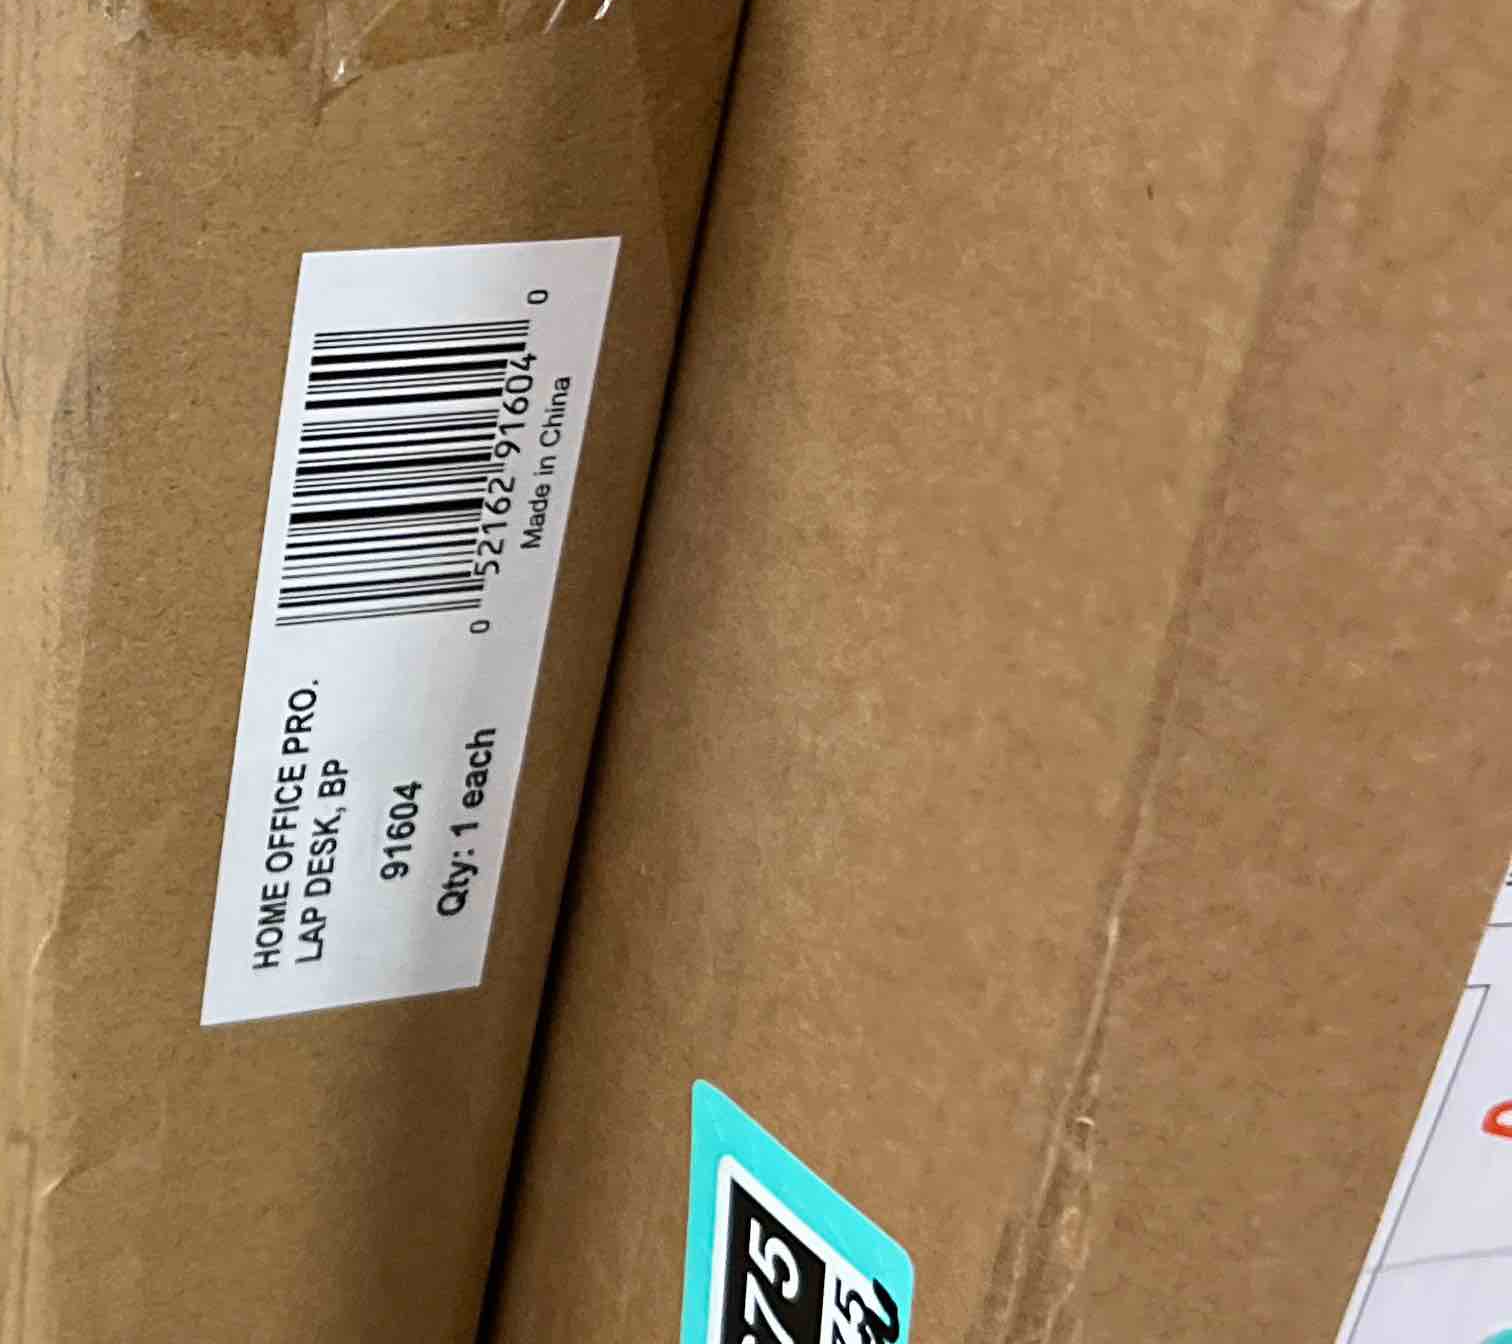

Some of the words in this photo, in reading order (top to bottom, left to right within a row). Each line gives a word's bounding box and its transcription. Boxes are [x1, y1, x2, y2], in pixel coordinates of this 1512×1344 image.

[493, 352, 538, 458] 91604
[540, 376, 572, 448] China
[533, 455, 556, 478] in
[474, 475, 516, 577] 52162
[520, 484, 552, 550] Made
[282, 679, 320, 756] PRO.
[318, 758, 349, 799] BP
[462, 727, 497, 809] each
[266, 763, 307, 874] OFFICE
[304, 806, 347, 898] DESK,
[380, 780, 423, 881] 91604
[450, 822, 480, 837] 1
[437, 849, 479, 917] Qty:
[252, 880, 290, 970] HOME
[295, 907, 328, 964] LAP
